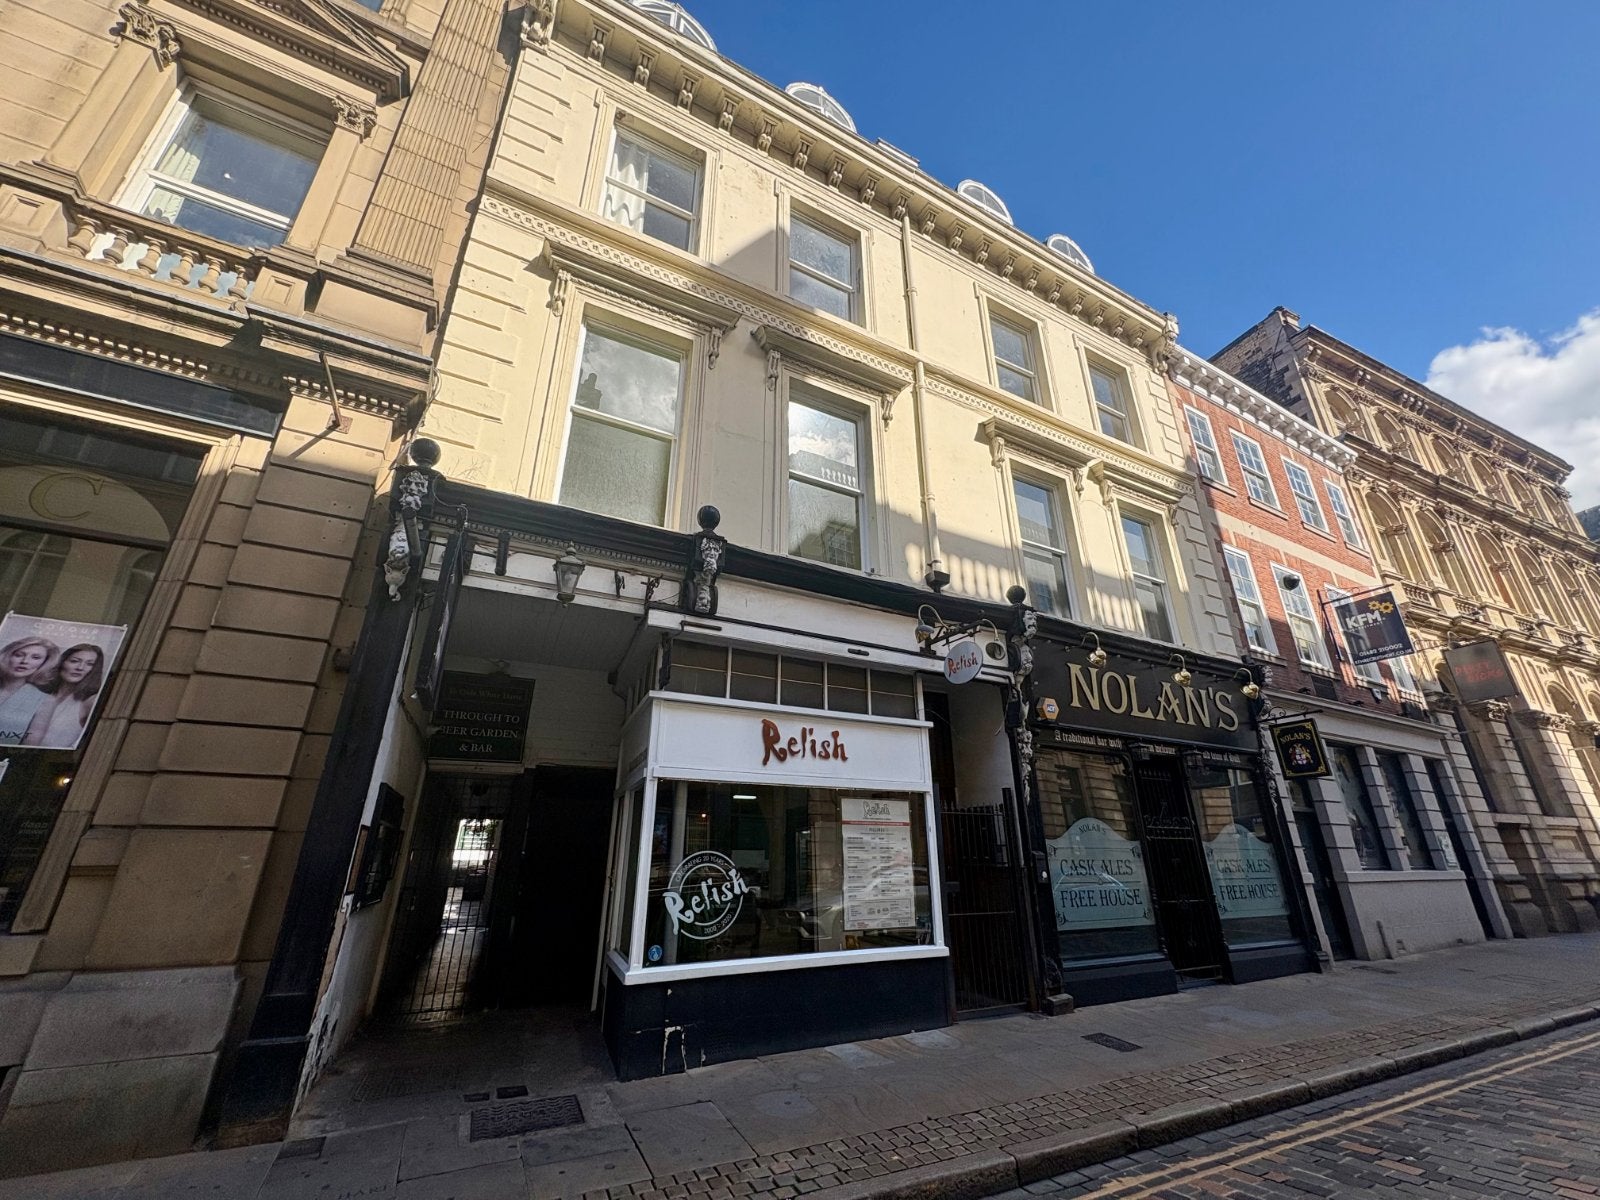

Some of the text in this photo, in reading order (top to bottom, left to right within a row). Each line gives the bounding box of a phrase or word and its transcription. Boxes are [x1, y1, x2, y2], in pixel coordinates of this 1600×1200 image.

[1345, 610, 1382, 629] KFM
[947, 651, 978, 678] Relish
[1066, 662, 1240, 732] NOLAN'S
[444, 710, 521, 724] THROUGH TO
[470, 727, 519, 738] GARDEN
[761, 718, 849, 766] Relish
[1280, 732, 1311, 745] NOLAN'S
[459, 743, 493, 753] & BAR
[1060, 858, 1133, 877] CASK ALES
[1216, 858, 1271, 874] CASK ALES
[662, 868, 749, 935] Relish
[1060, 887, 1143, 909] FREE HOUSE
[1219, 883, 1281, 901] FREE HOUSE
